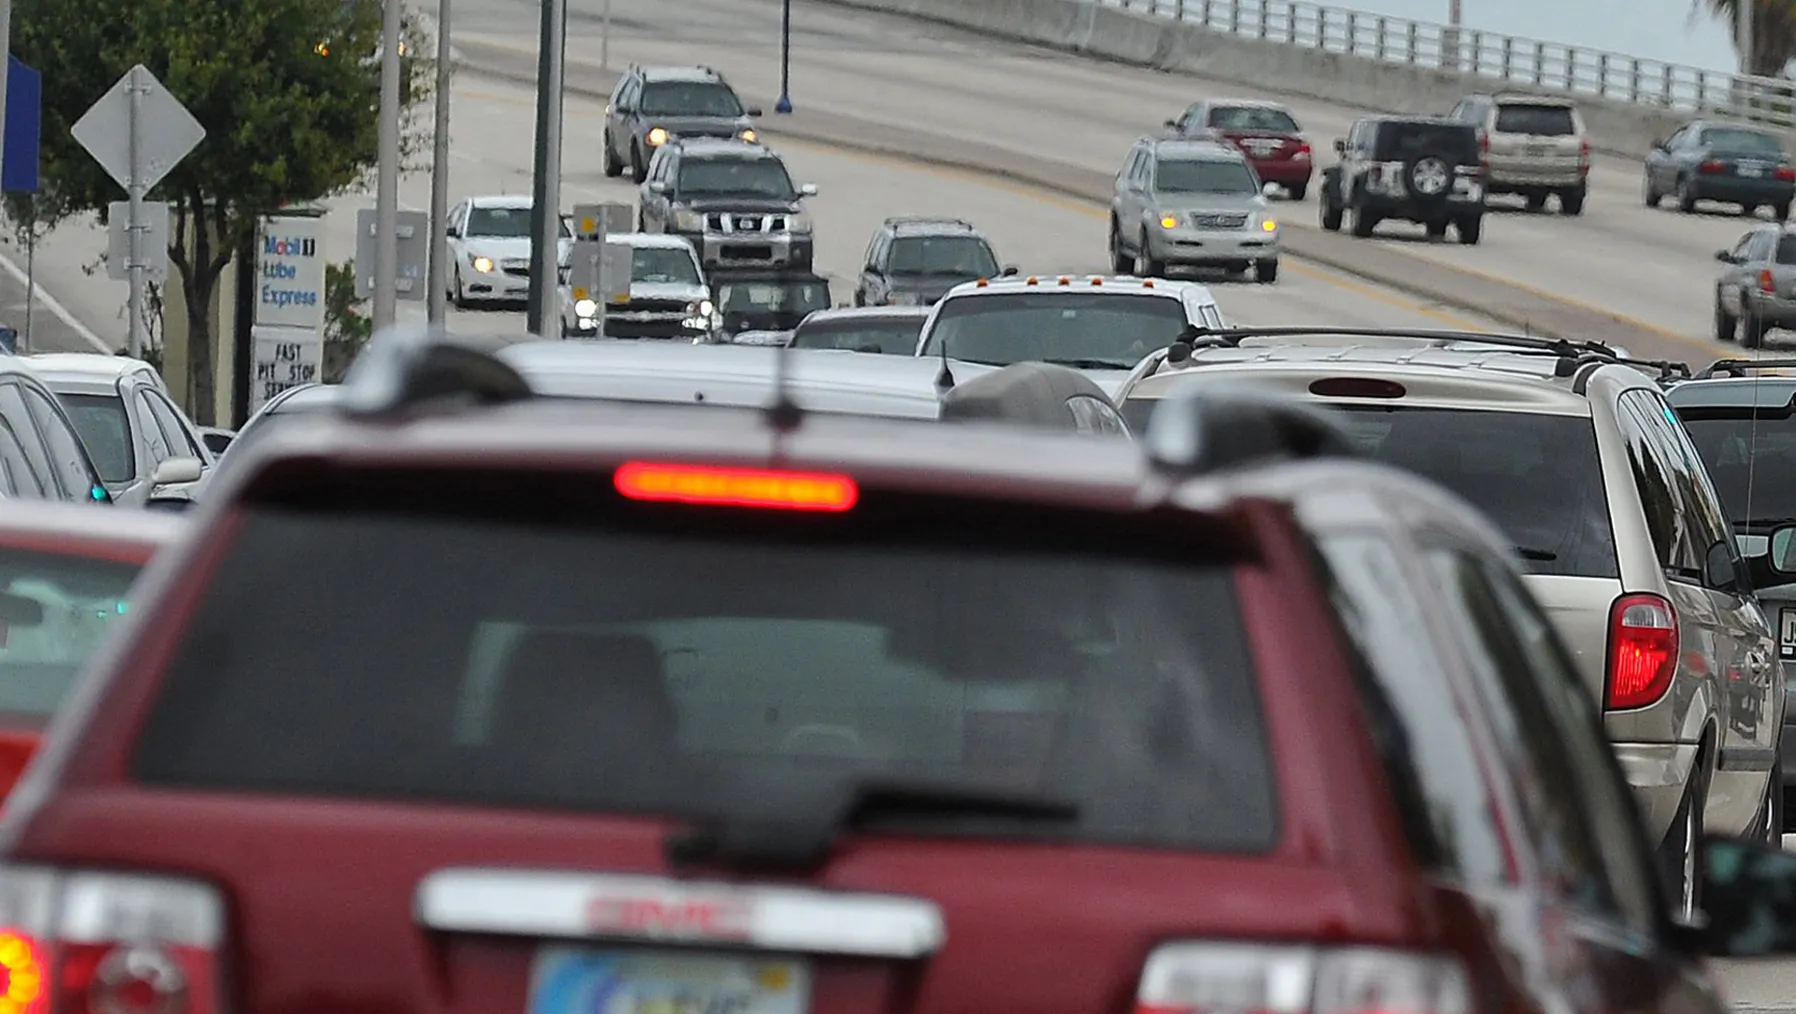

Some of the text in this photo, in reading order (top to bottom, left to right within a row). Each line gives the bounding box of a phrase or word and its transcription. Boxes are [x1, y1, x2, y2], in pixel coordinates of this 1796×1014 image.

[263, 235, 300, 255] Mobil
[263, 260, 296, 279] Lube
[261, 284, 317, 308] Express
[258, 362, 316, 381] PIT STOP
